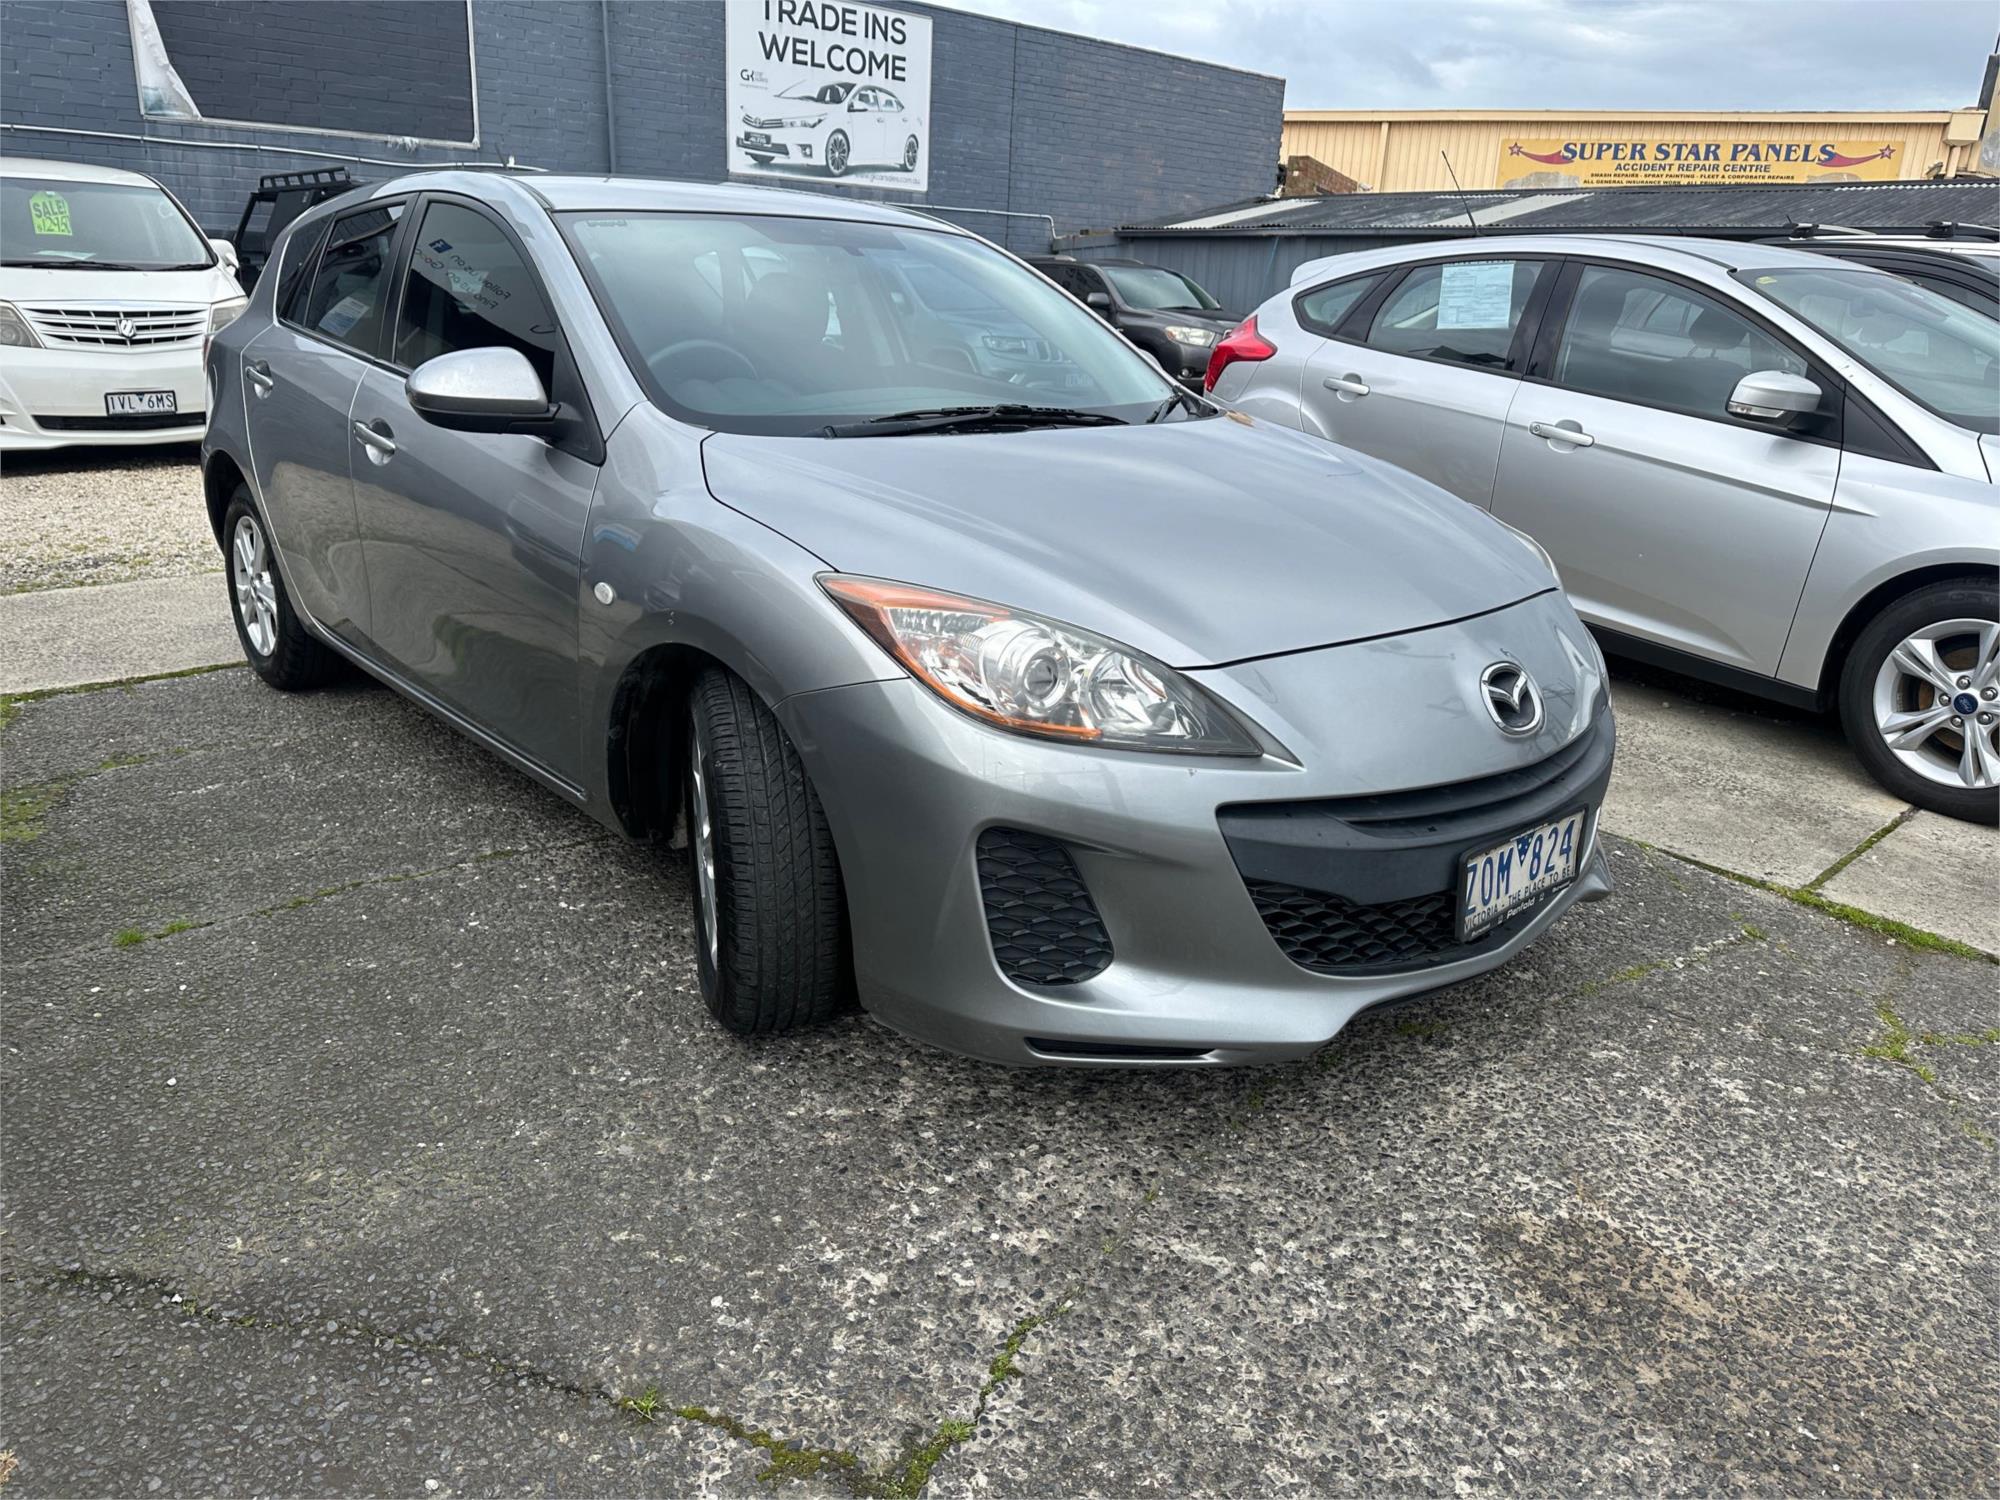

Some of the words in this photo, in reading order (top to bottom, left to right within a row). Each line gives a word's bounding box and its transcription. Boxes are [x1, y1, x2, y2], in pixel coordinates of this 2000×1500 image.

[864, 12, 907, 45] INS
[758, 31, 907, 82] WELCOME
[1561, 142, 1647, 161] SUPER
[1654, 143, 1721, 161] STAR
[1730, 143, 1835, 163] PANELS
[1615, 163, 1674, 172] ACCIDENT
[1677, 163, 1720, 172] REPAIR
[1723, 164, 1771, 173] CENTRE
[147, 394, 174, 409] 6MS
[1465, 847, 1514, 917] ZOM
[1529, 819, 1576, 881] 824
[1464, 905, 1498, 931] VICTORIA
[1508, 891, 1522, 906] THE
[1524, 877, 1546, 896] PLACE
[1549, 872, 1559, 884] TO
